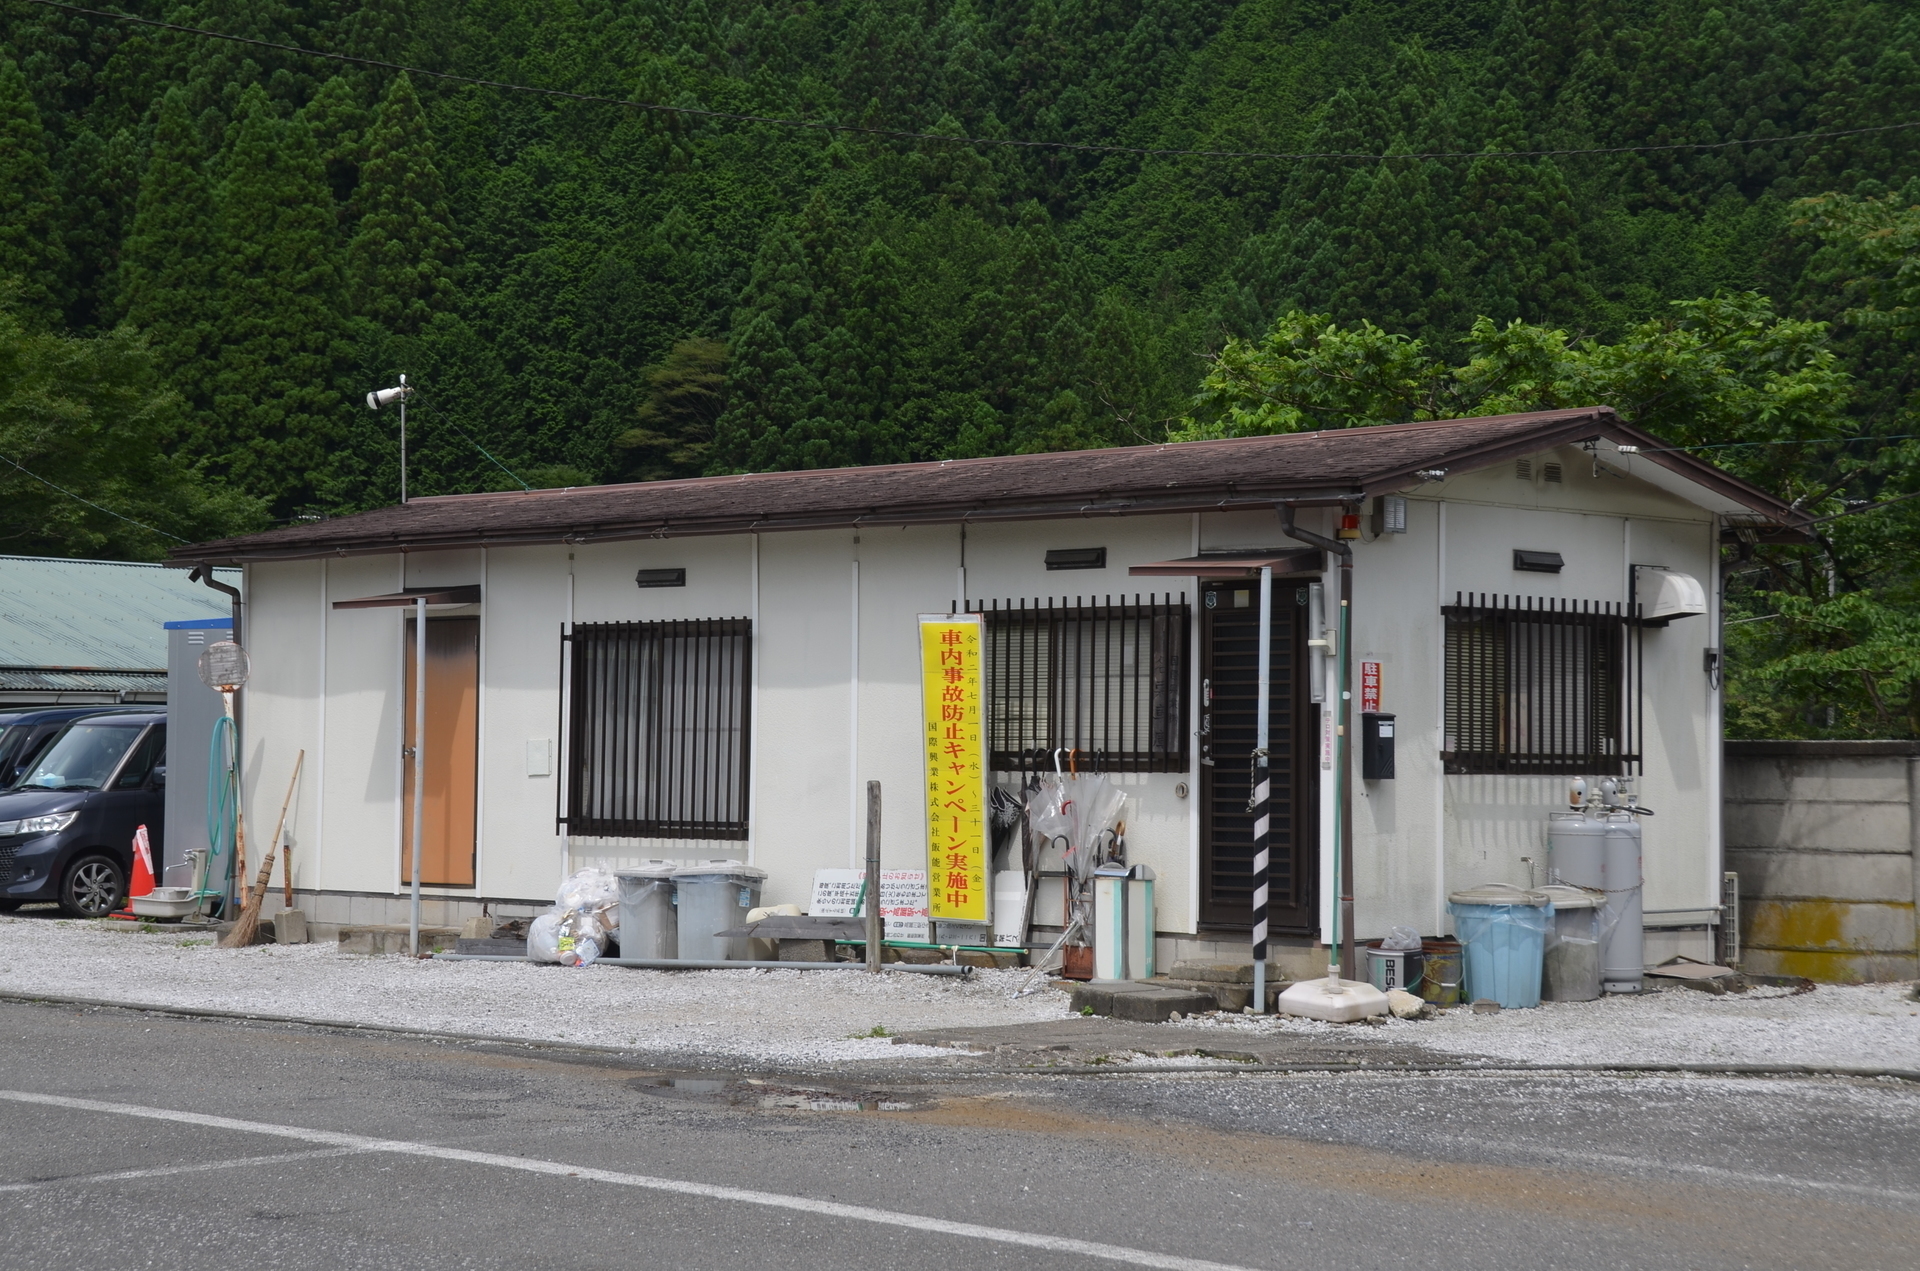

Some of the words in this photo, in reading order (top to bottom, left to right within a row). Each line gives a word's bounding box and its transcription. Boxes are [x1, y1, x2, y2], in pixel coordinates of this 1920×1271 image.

[939, 629, 969, 908] 車内事故防止キャンペーン実施中
[1364, 663, 1378, 712] 駐車禁止
[928, 722, 941, 913] 国際興業株式会社飯能営業所
